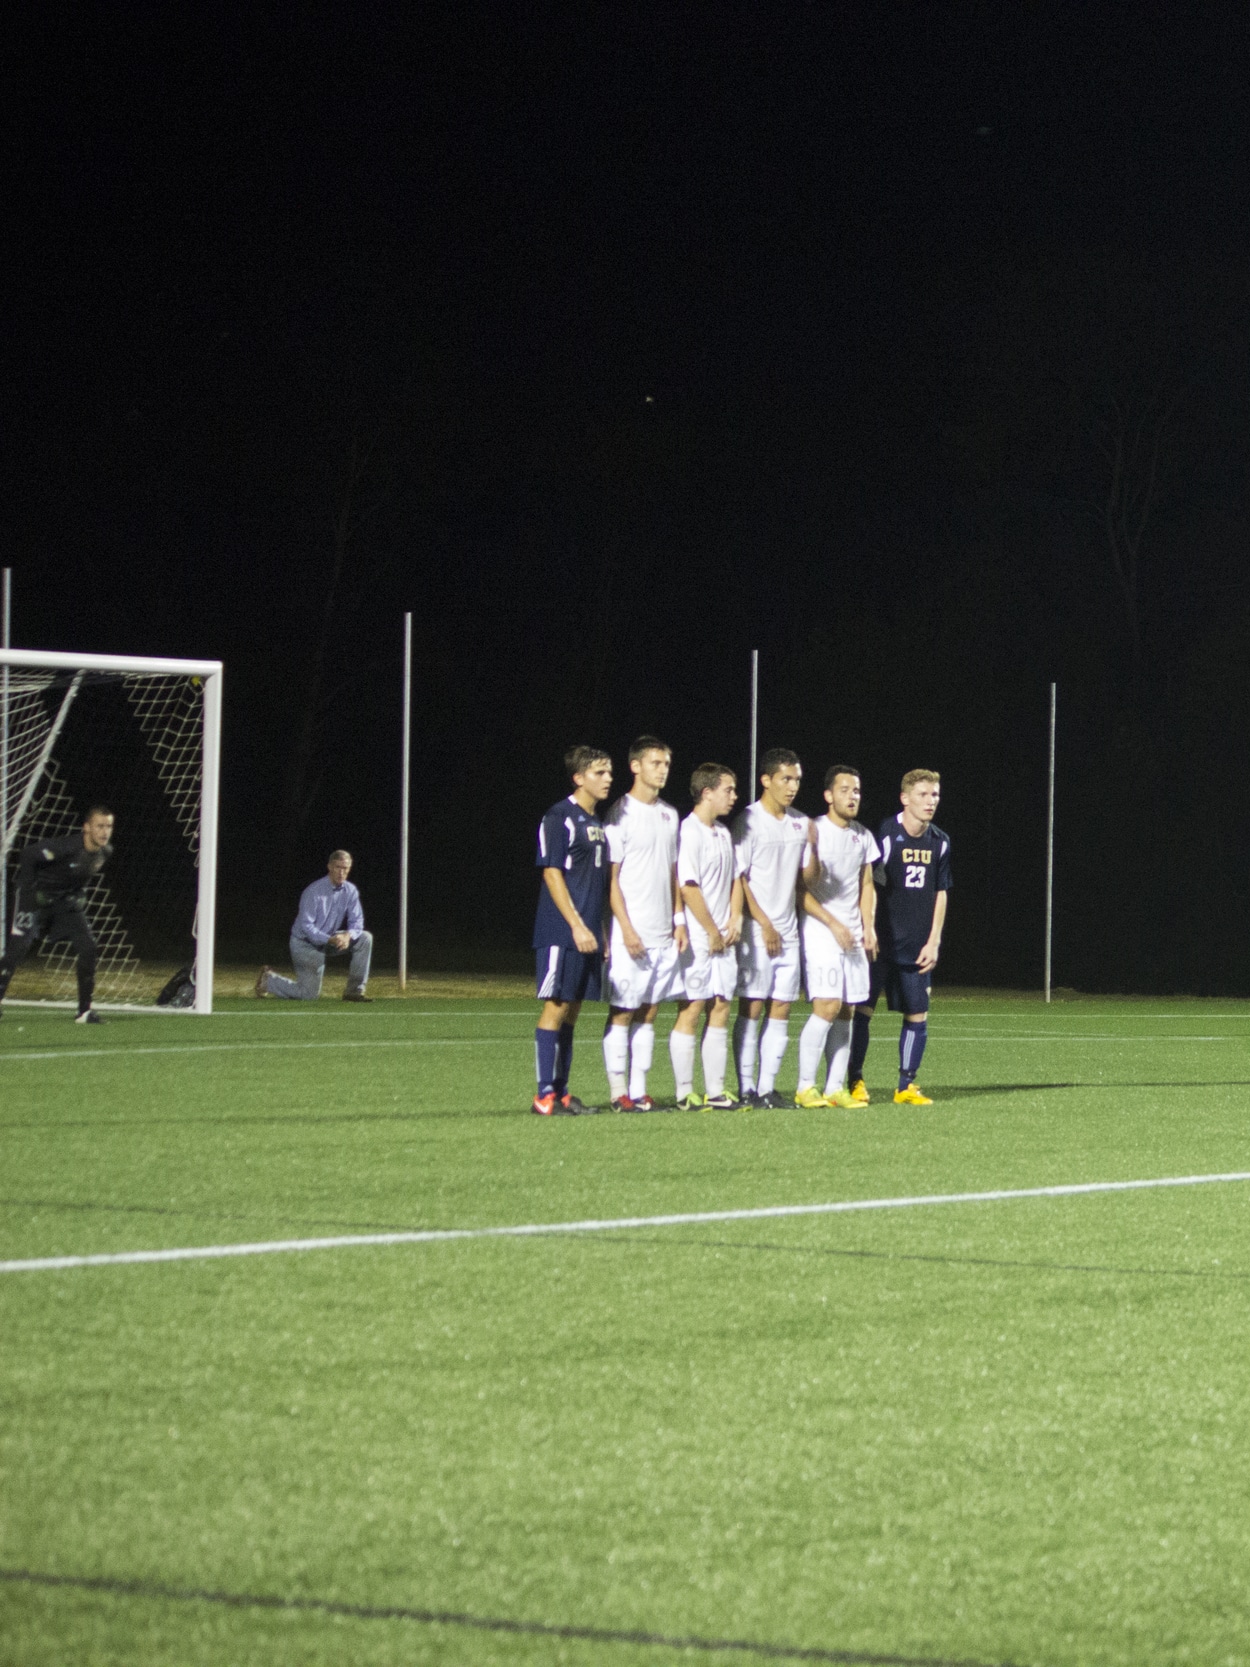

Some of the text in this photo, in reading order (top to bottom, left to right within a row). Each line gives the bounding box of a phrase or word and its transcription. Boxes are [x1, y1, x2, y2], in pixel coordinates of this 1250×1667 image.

[902, 848, 932, 864] CIU
[905, 865, 926, 888] 23
[817, 966, 838, 988] 10
